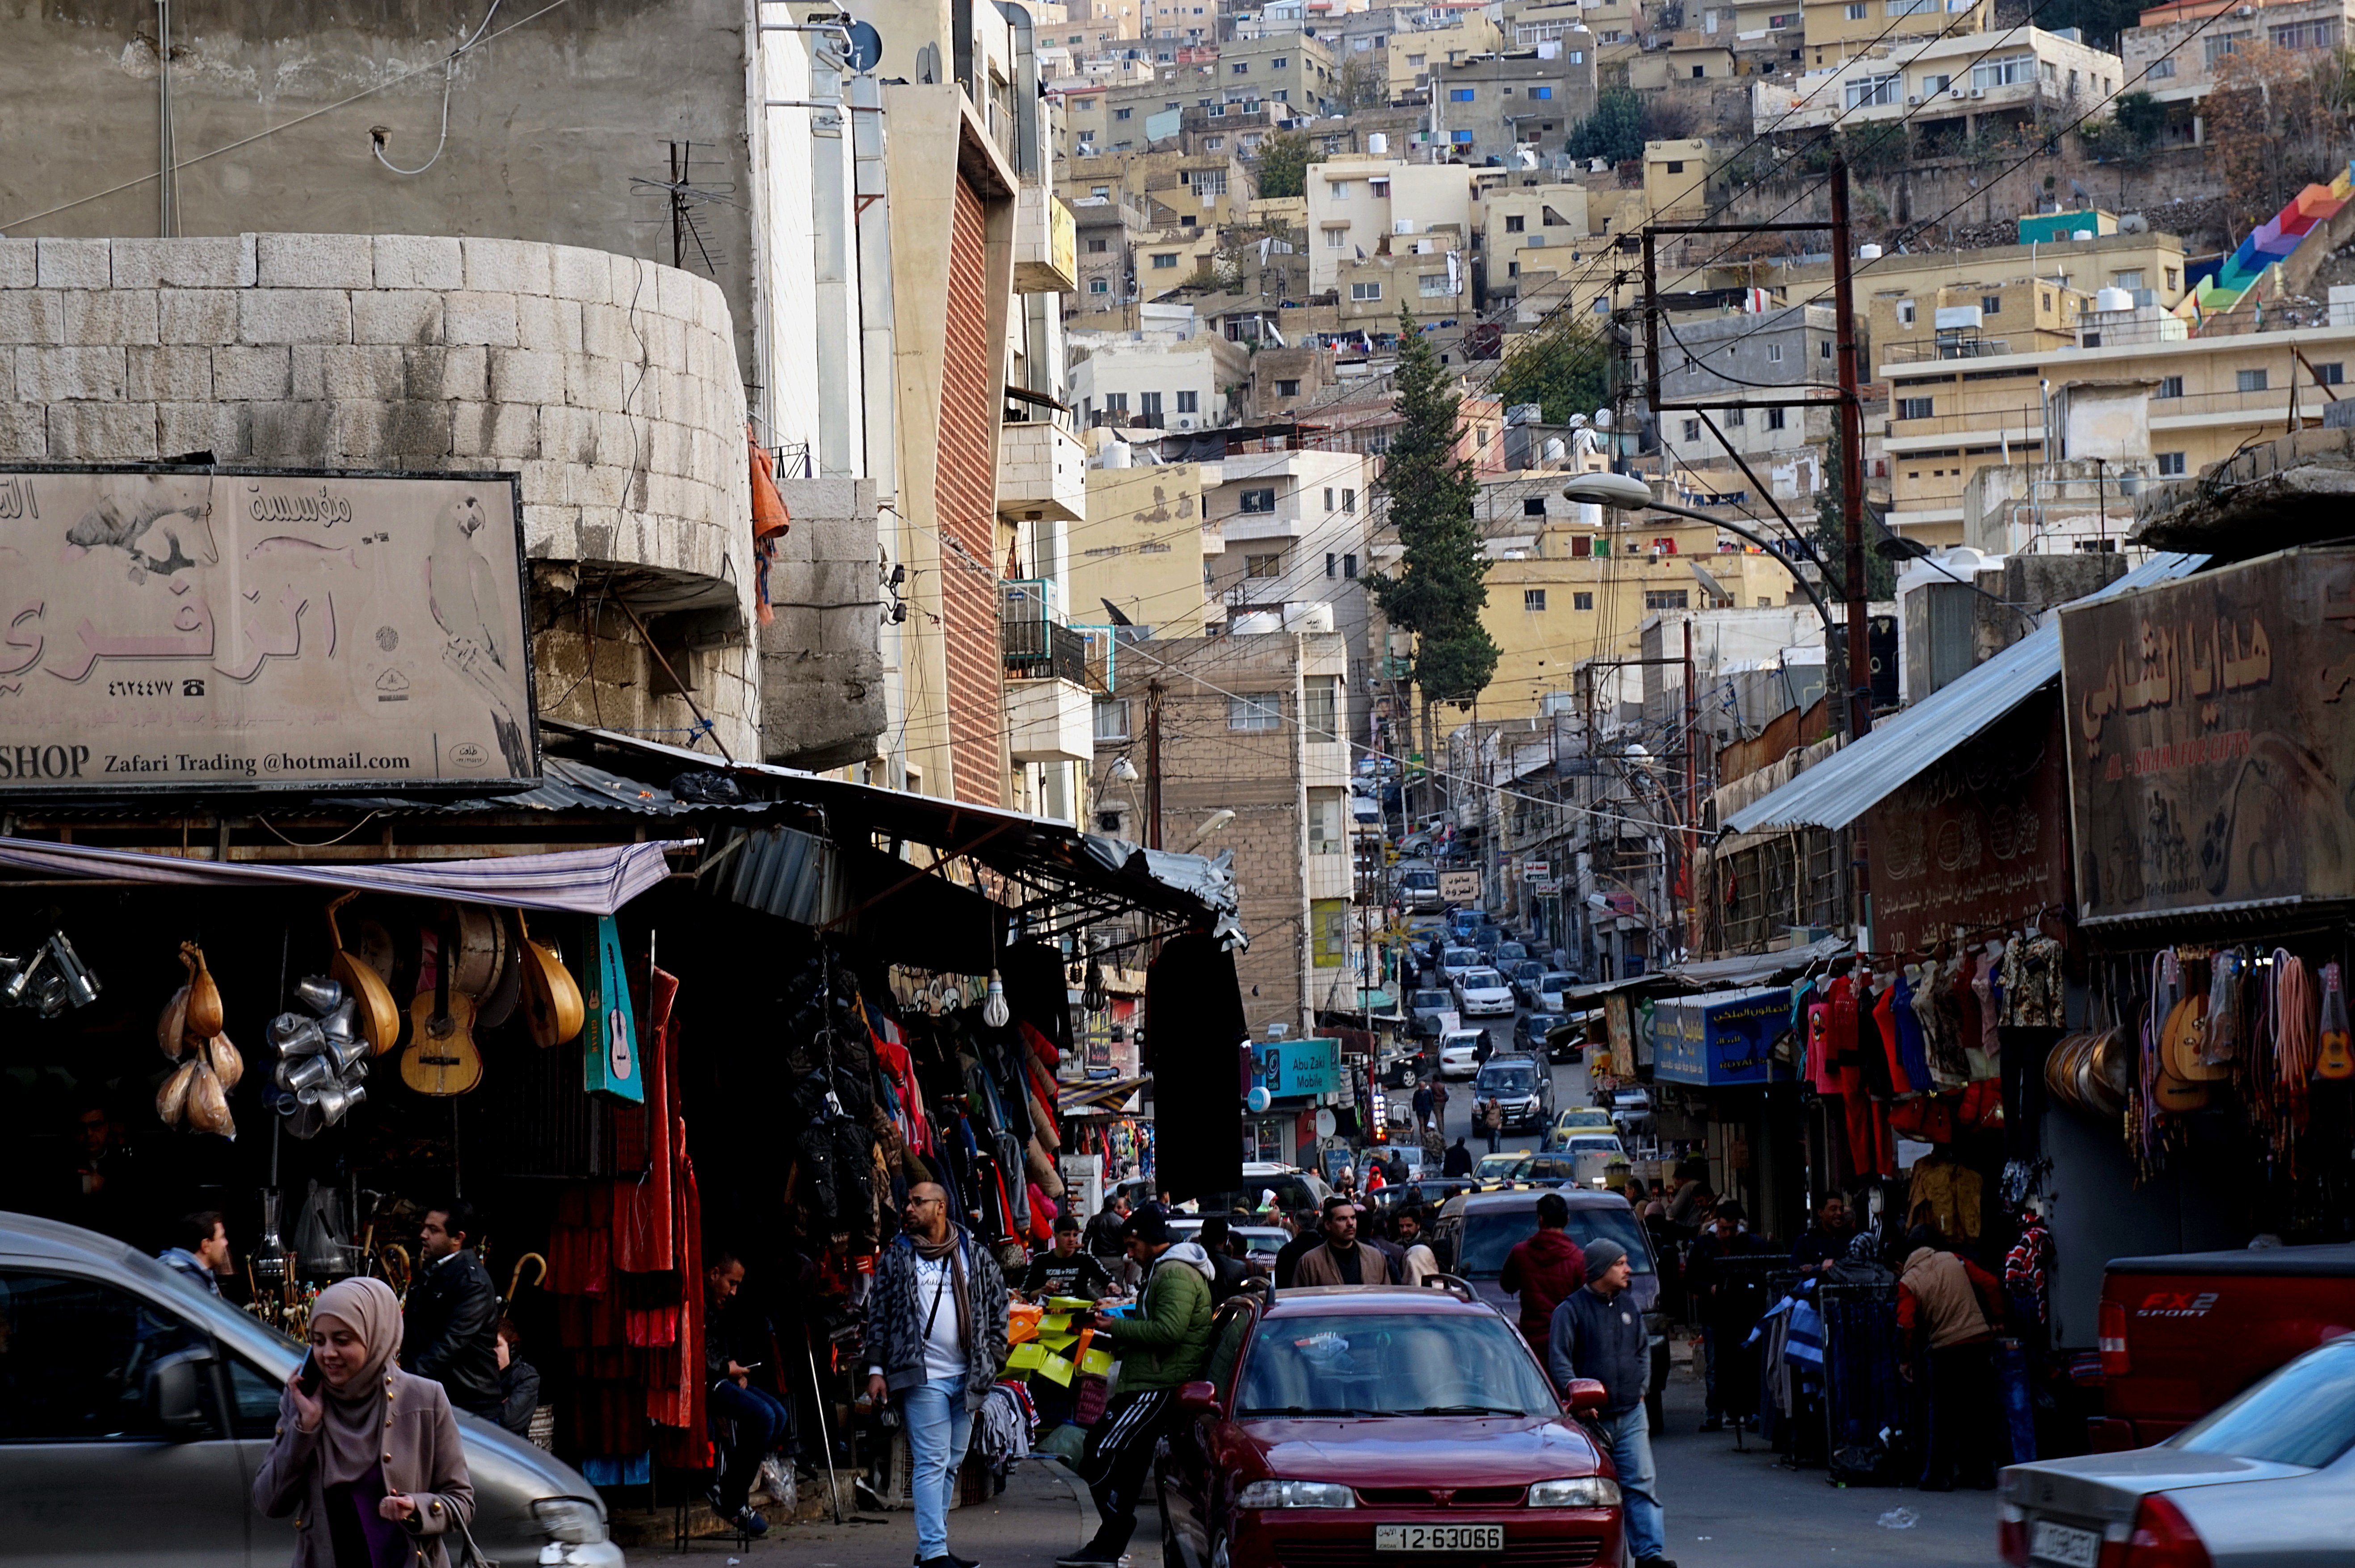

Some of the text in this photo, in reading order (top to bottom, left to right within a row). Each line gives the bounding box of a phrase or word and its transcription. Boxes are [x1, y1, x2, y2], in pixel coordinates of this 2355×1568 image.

[2187, 617, 2272, 728] هدايا
[109, 679, 174, 697] ٤٦٢٤٤٧٧
[2082, 619, 2181, 761] الشامي
[2181, 737, 2206, 765] FOR
[2210, 731, 2250, 761] GIFTS
[0, 745, 90, 779] SHOP
[105, 752, 410, 777] Zafari Trading @hotmail.com
[1890, 931, 1905, 954] 2JD
[1713, 1003, 1789, 1024] الصالون الملكي
[1293, 1055, 1325, 1071] Abu Zaki
[1720, 1059, 1754, 1069] ROYAL
[1297, 1073, 1322, 1088] Mobile
[2141, 1292, 2220, 1309] FX2
[2136, 1309, 2211, 1317] SPORT
[1401, 1528, 1499, 1548] 12-63066
